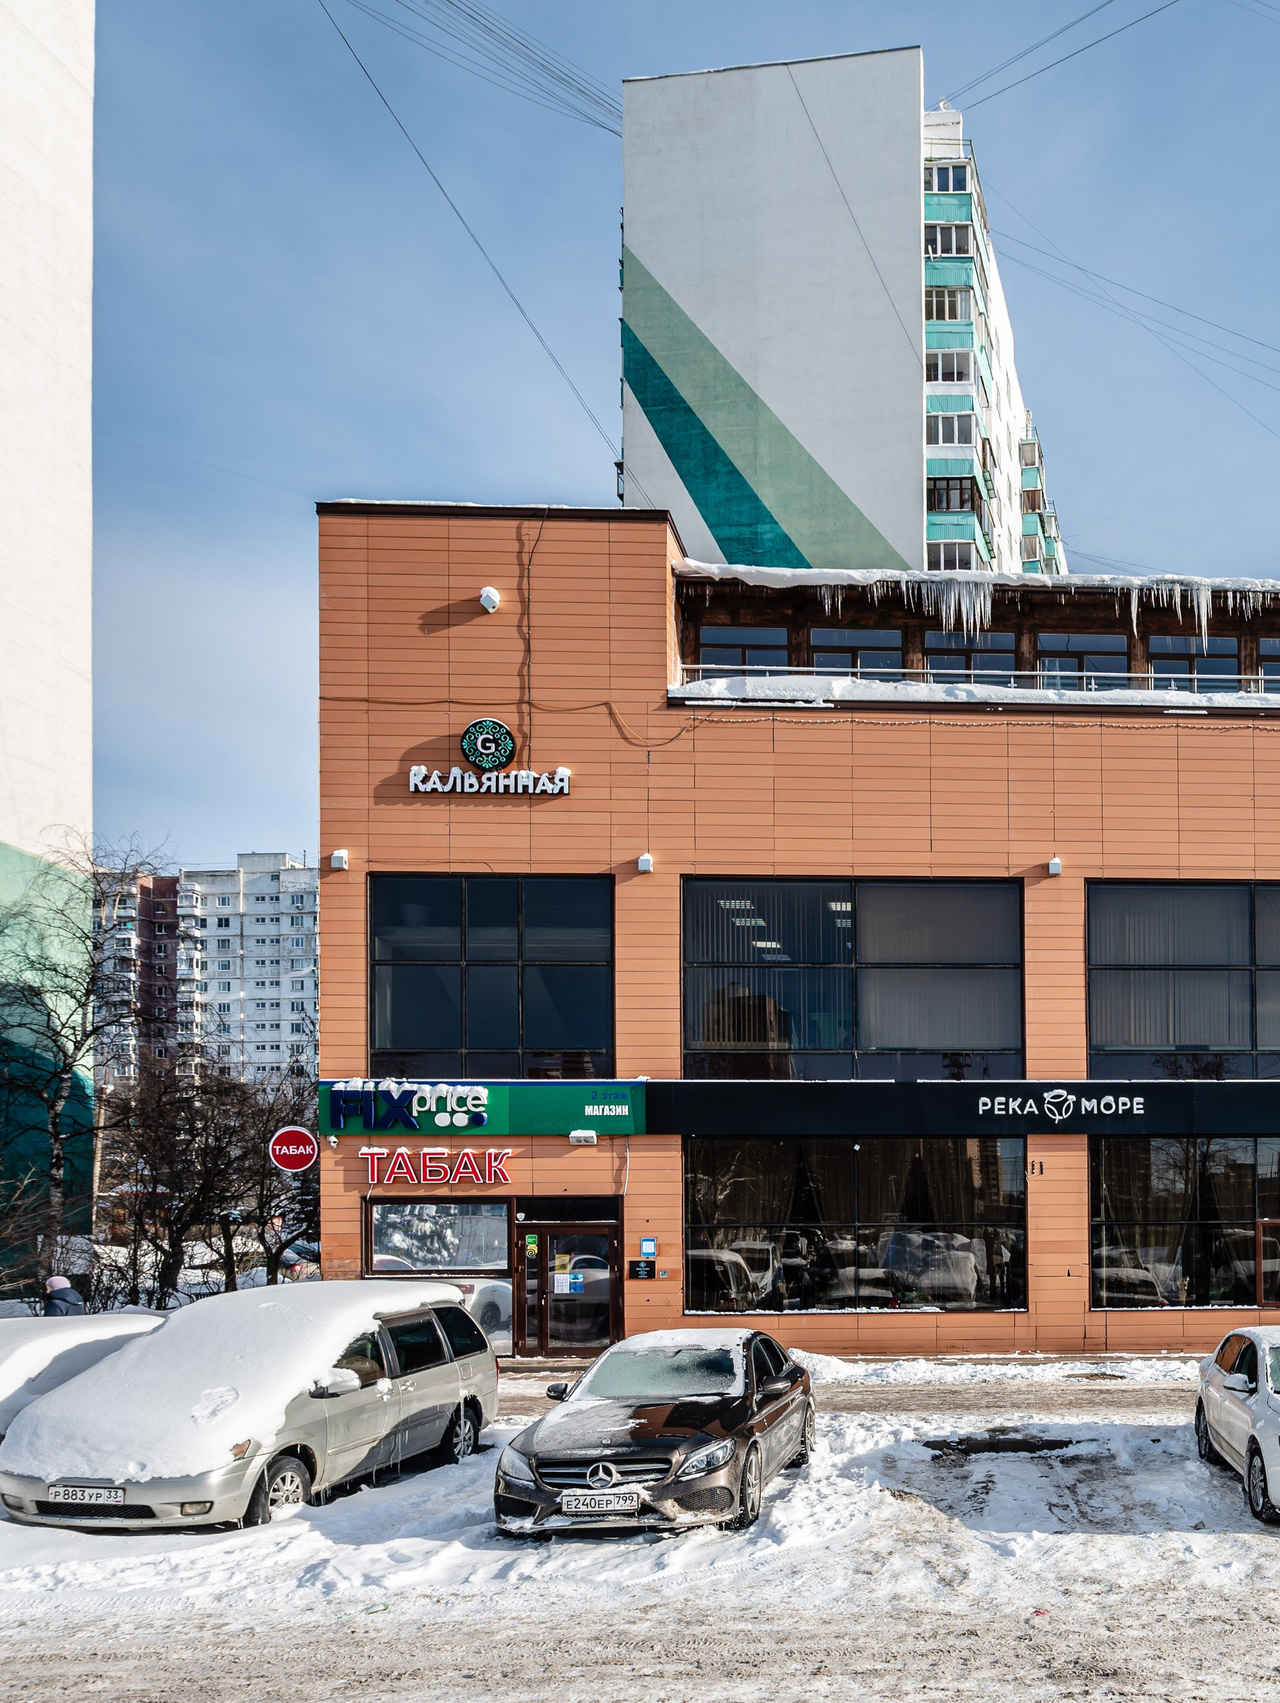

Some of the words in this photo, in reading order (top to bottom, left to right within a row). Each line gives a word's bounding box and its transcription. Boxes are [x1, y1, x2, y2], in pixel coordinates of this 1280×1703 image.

[476, 734, 496, 754] G
[409, 769, 571, 795] КАЛЬЯННАЯ
[591, 1090, 598, 1101] 2
[330, 1089, 420, 1129] FIX
[412, 1091, 488, 1117] price
[584, 1105, 629, 1116] МАГАЗИН
[978, 1097, 1039, 1115] РЕКА
[1081, 1097, 1145, 1115] МОРЕ
[273, 1145, 314, 1155] ТАБАК
[358, 1149, 512, 1184] ТАБАК
